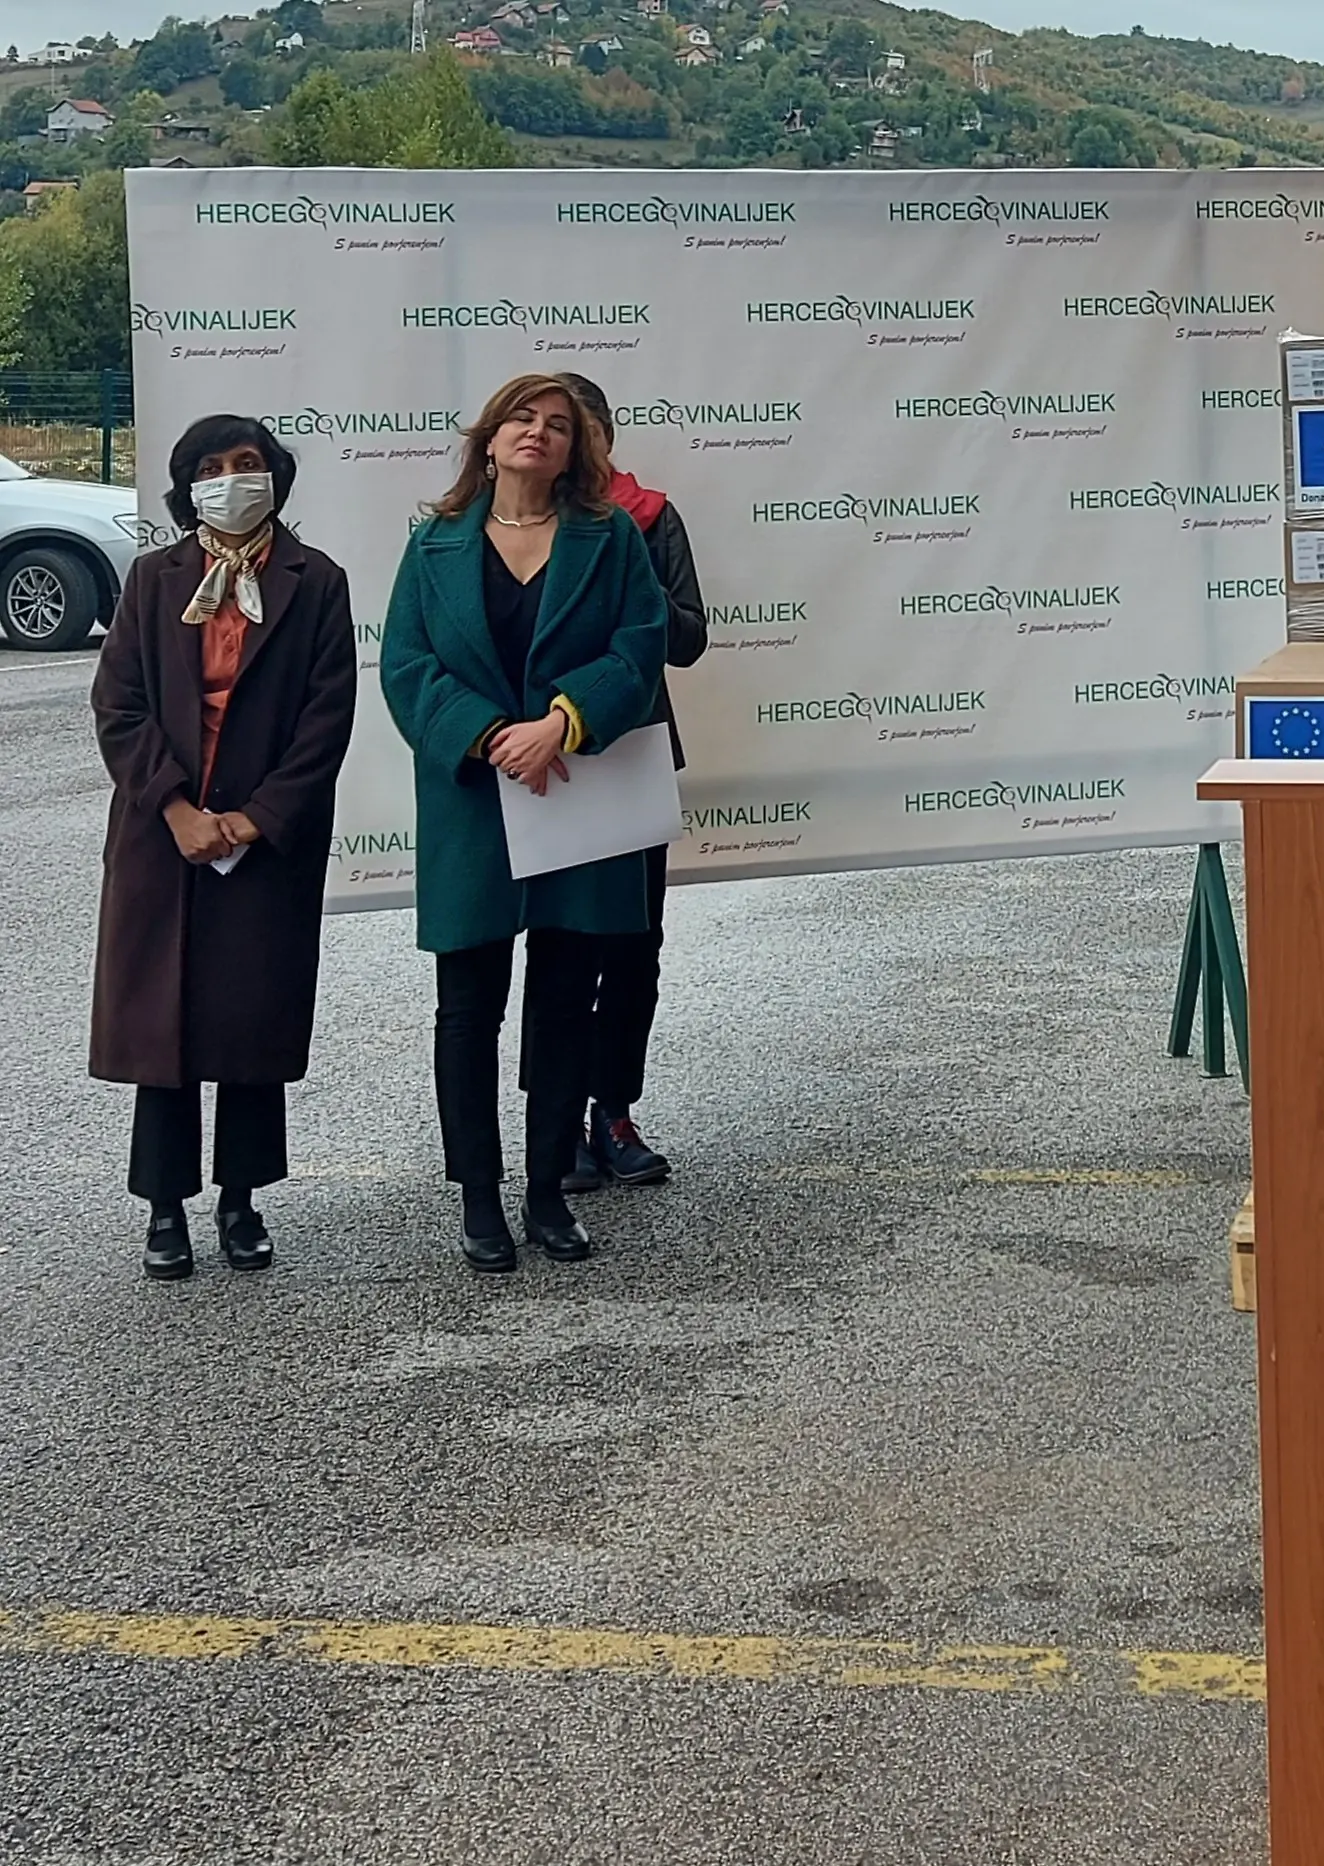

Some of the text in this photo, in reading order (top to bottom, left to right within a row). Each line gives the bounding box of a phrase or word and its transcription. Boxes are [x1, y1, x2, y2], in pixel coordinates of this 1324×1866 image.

[197, 196, 454, 229] HERCEGOVINALIJEK
[558, 197, 795, 228] HERCEGOVINALIJEK
[890, 195, 1108, 225] HERCEGOVINALIJEK
[403, 300, 649, 331] HERCEGOVINALIJEK
[748, 295, 974, 326] HERCEGOVINALIJEK
[1065, 291, 1274, 319] HERCEGOVINALIJEK
[896, 391, 1115, 419] HERCEGOVINALIJEK
[754, 494, 979, 523] HERCEGOVINALIJEK
[1071, 482, 1280, 510] HERCEGOVINALIJEK
[901, 586, 1120, 615] HERCEGOVINALIJEK
[758, 691, 985, 722] HERCEGOVINALIJEK
[906, 779, 1124, 815] HERCEGOVINALIJEK
